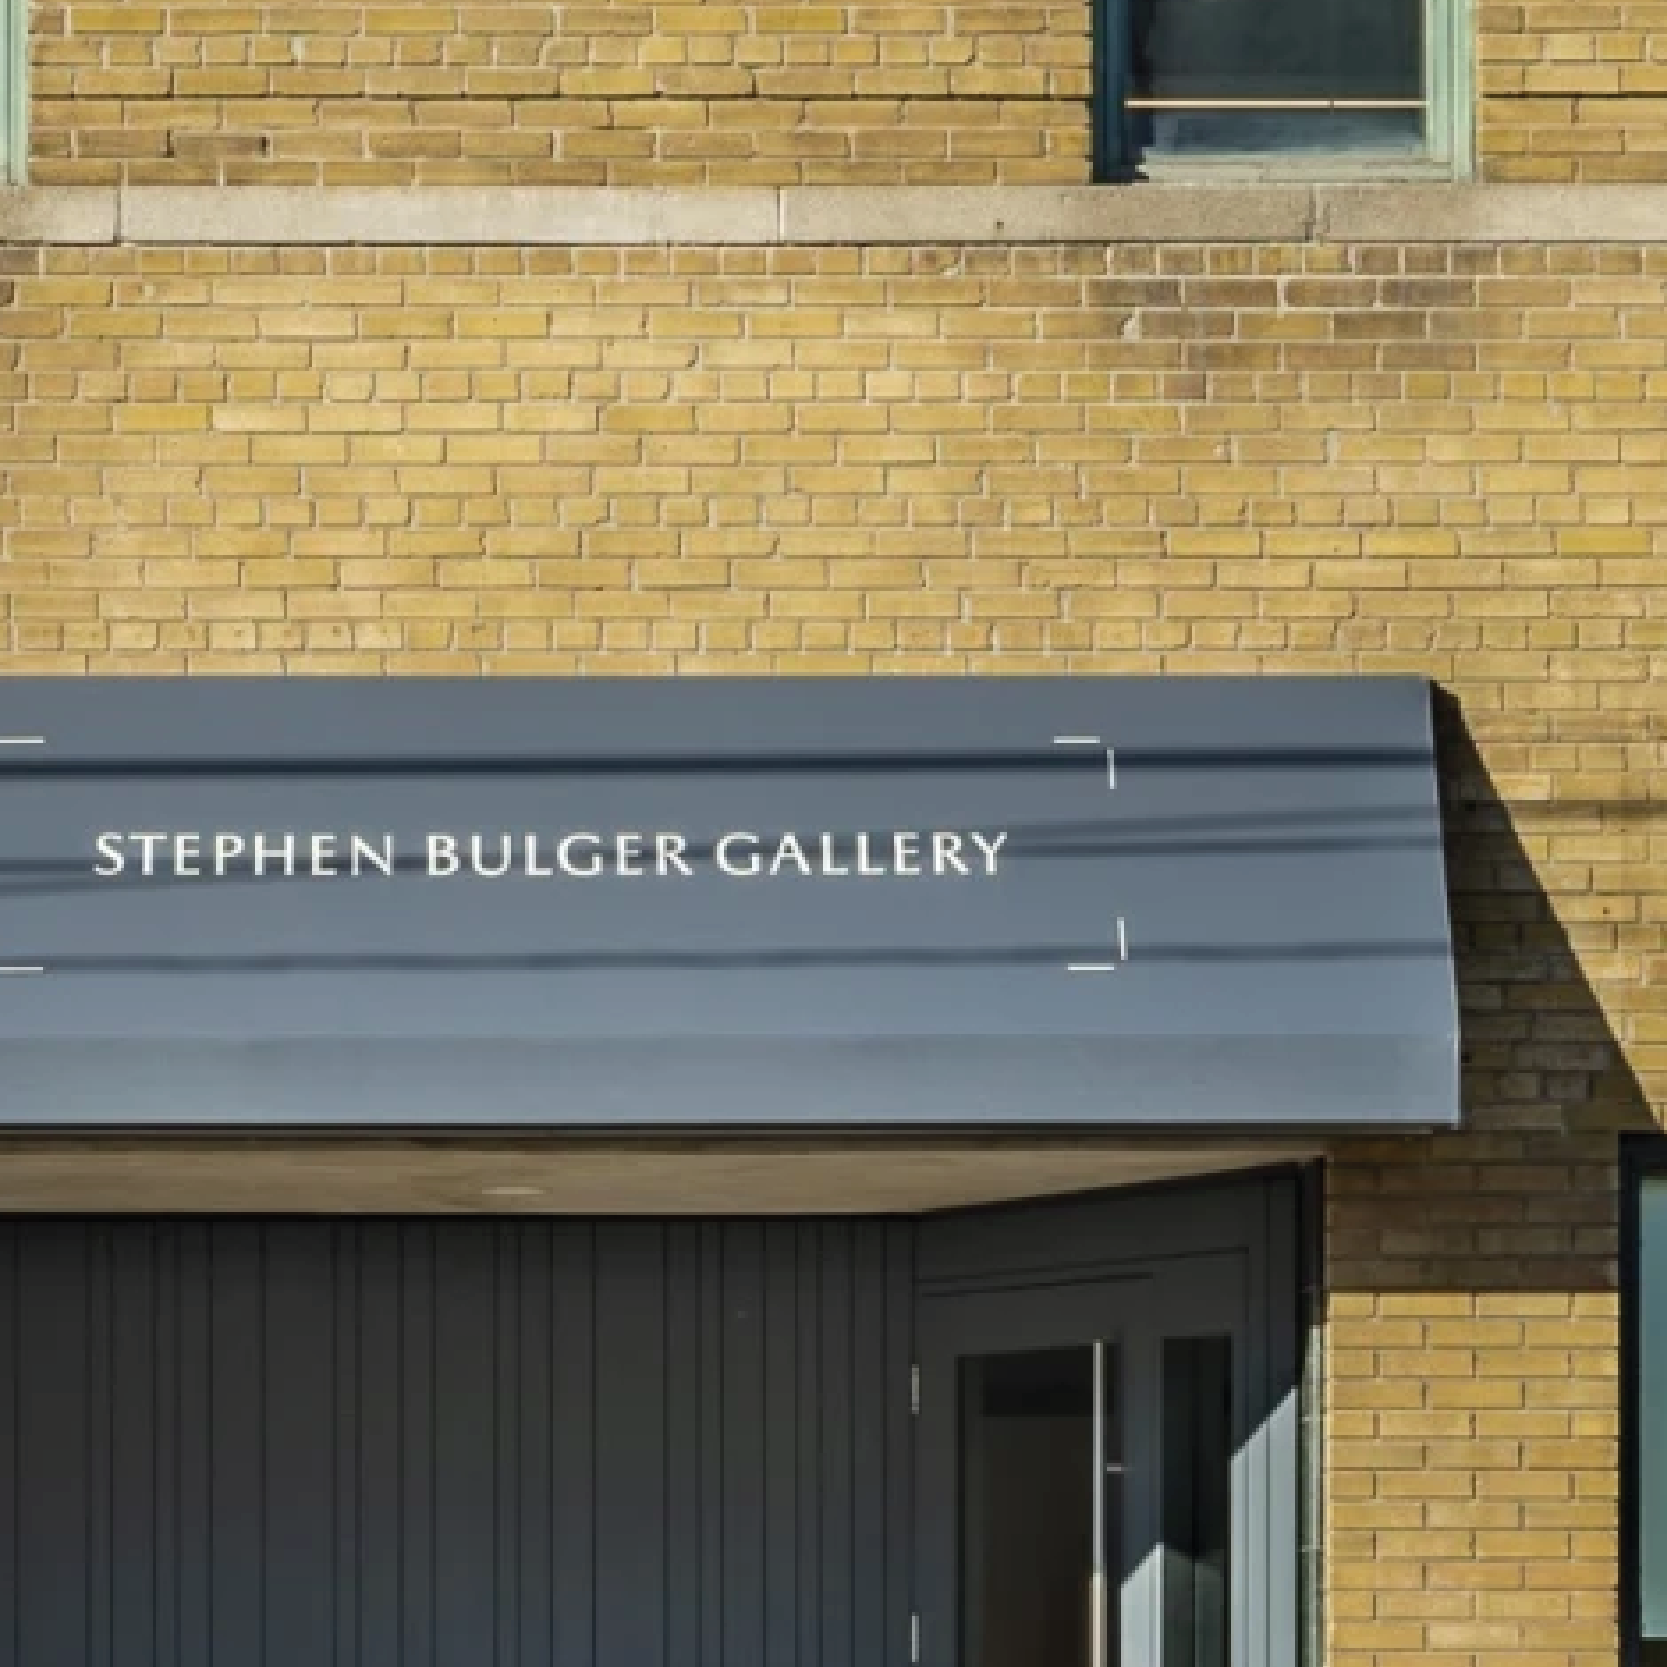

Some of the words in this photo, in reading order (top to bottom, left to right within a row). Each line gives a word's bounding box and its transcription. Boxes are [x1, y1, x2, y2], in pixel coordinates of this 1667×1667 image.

[94, 832, 396, 876] STEPHEN
[424, 832, 693, 876] BULGER
[715, 831, 1008, 876] GALLERY
